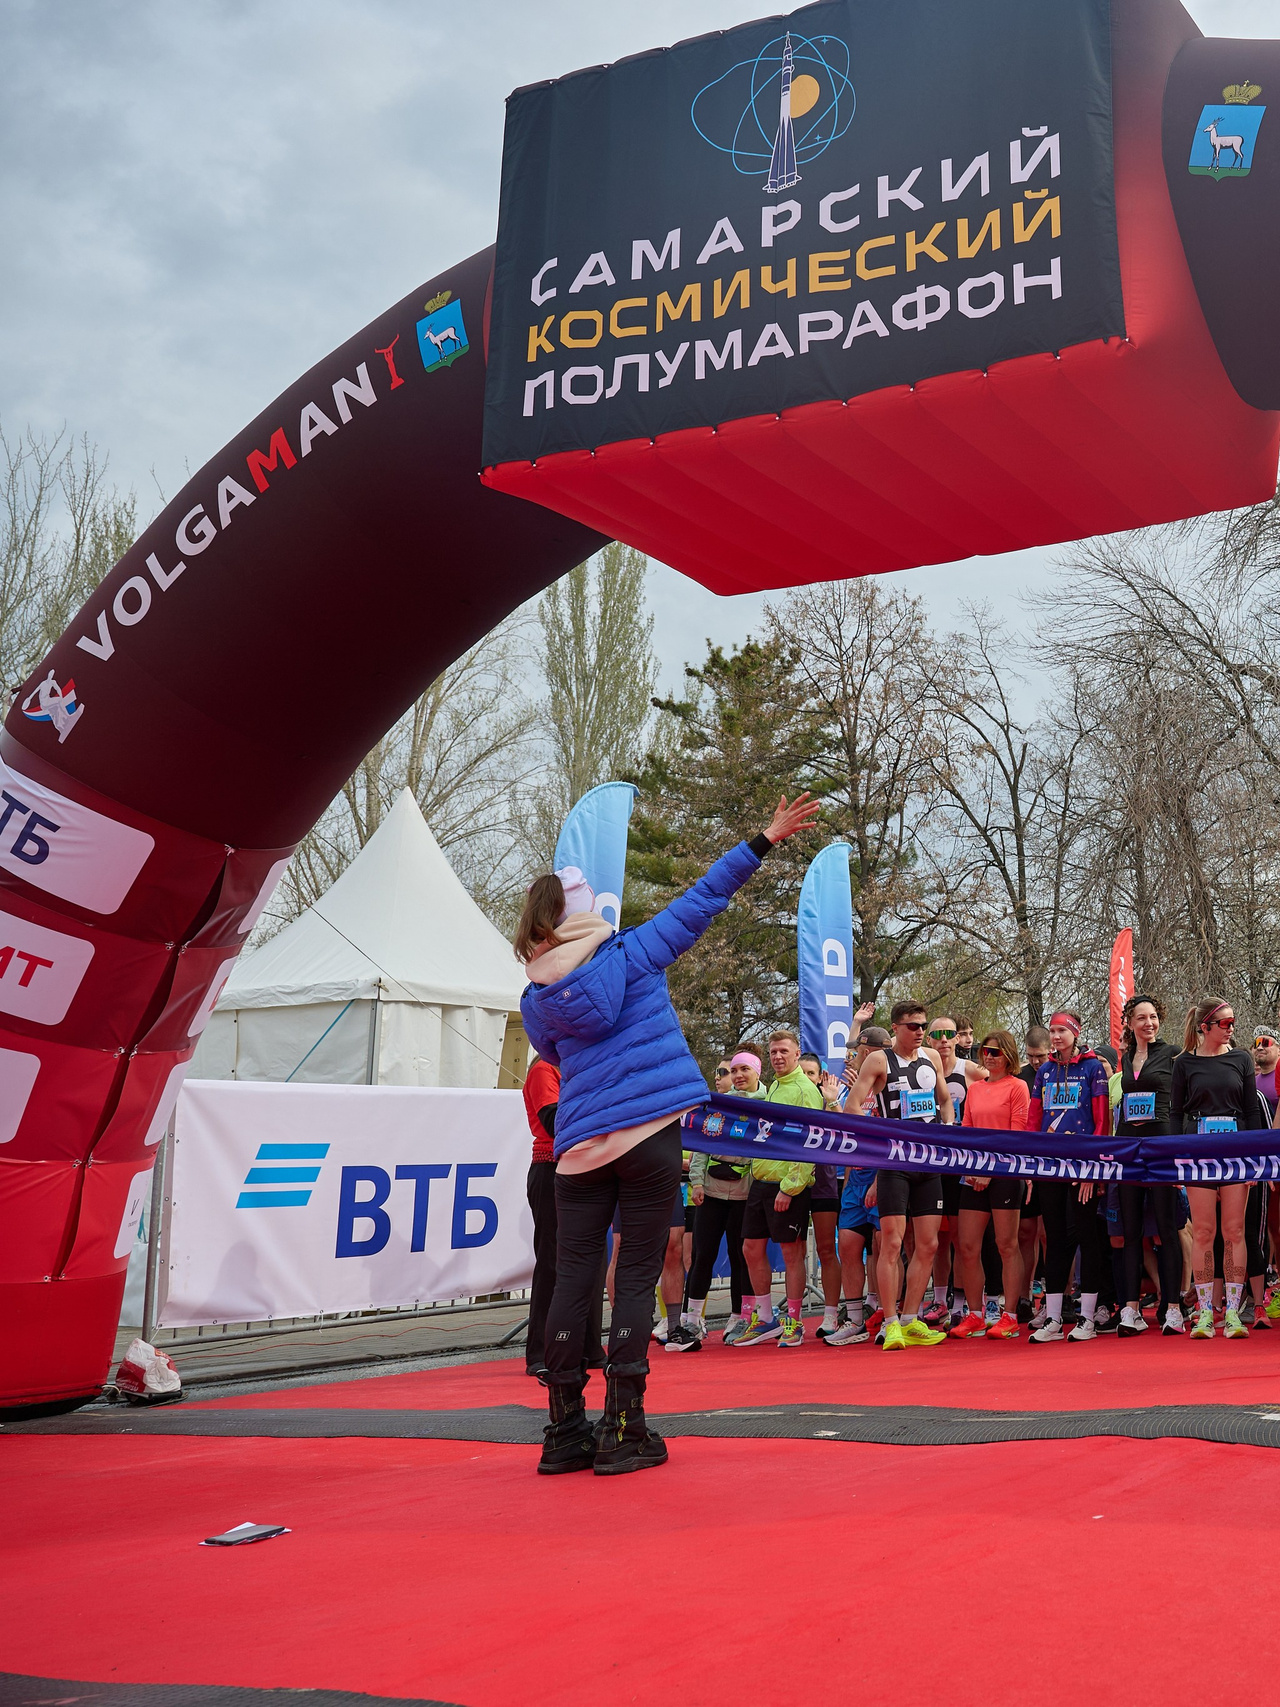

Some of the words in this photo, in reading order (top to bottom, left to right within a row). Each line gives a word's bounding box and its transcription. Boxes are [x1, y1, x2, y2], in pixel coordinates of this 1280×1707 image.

[530, 126, 1062, 306] САМАРСКИЙ
[527, 188, 1062, 362] КОСМИЧЕСКИЙ
[522, 257, 1062, 416] ПОЛУМАРАФОН
[75, 362, 378, 662] VOLGAMAN
[803, 1124, 858, 1154] ВТБ
[910, 1099, 934, 1112] 5588
[1128, 1104, 1152, 1116] 5087
[887, 1138, 1124, 1181] КОСМИЧЕСКИЙ
[335, 1162, 499, 1259] ВТБ
